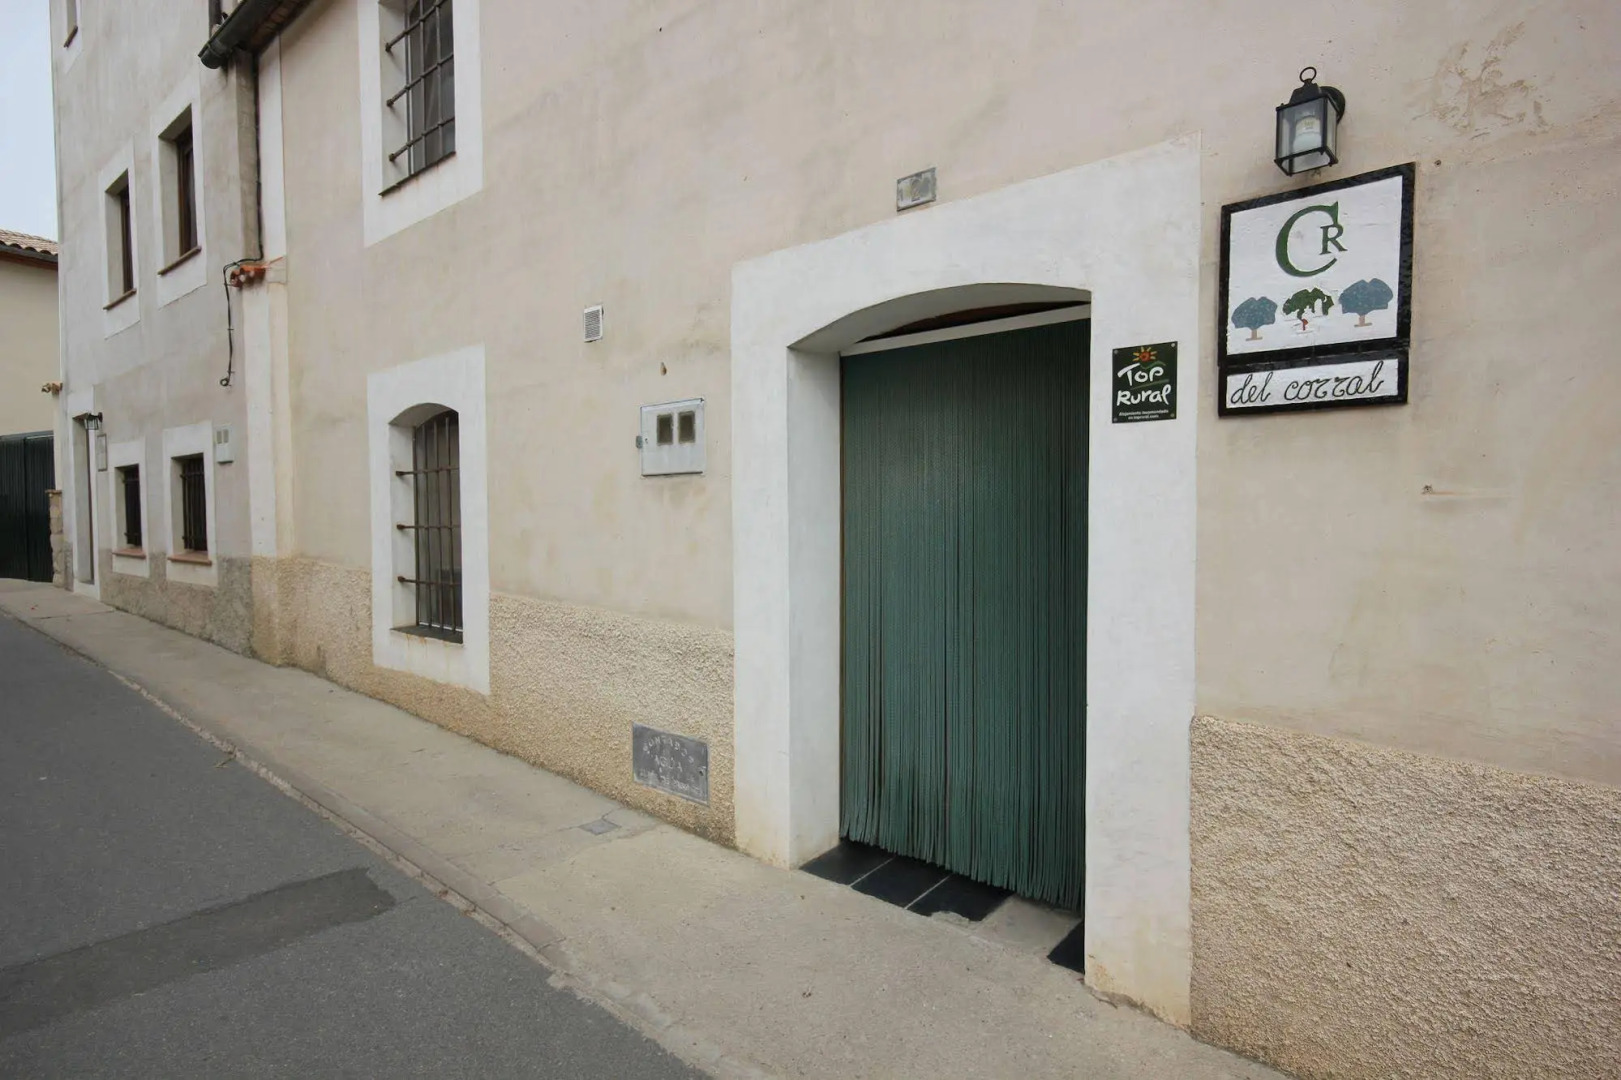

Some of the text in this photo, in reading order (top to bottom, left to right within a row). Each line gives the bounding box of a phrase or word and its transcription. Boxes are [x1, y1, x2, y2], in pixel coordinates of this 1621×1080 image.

[1117, 362, 1164, 386] Top
[1230, 360, 1384, 404] del corral
[1116, 384, 1172, 406] Rural
